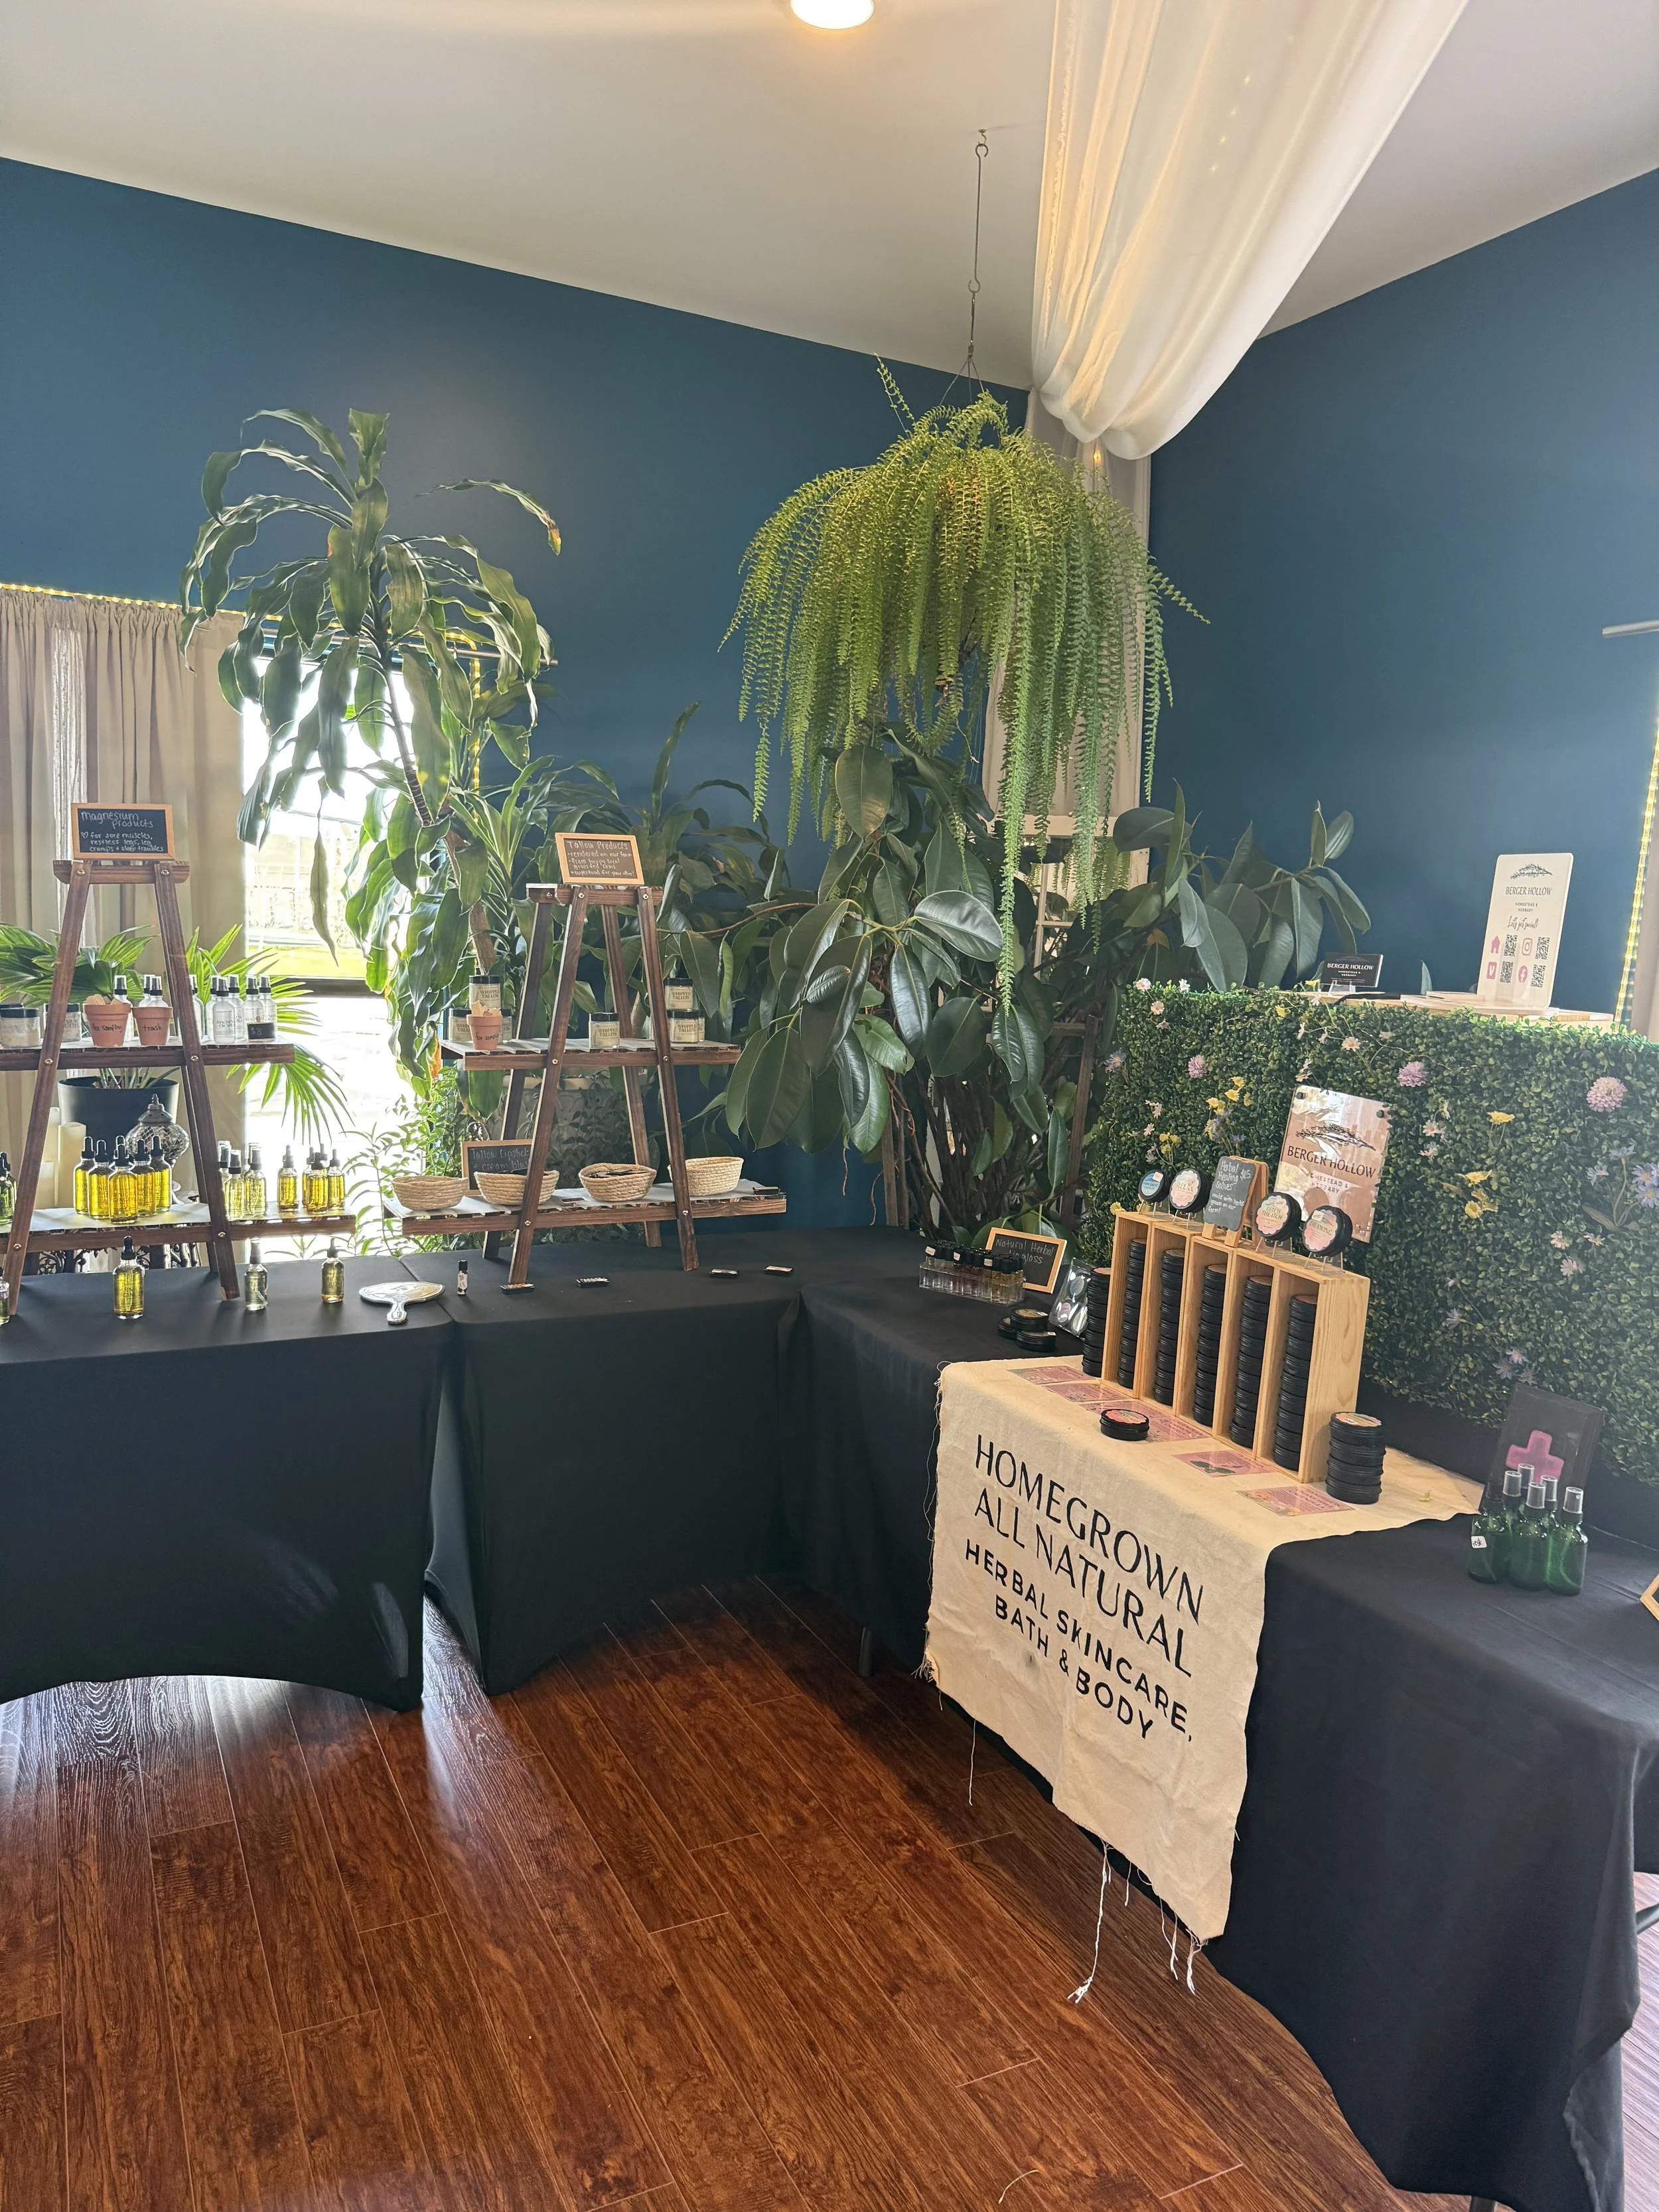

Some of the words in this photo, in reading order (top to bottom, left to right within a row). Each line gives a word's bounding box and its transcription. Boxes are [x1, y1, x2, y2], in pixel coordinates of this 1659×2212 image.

[111, 819, 154, 829] products
[567, 841, 594, 849] Tallow
[597, 841, 628, 849] Products
[1506, 887, 1527, 895] BERGER
[1528, 887, 1552, 896] HOLLOW
[470, 1148, 497, 1160] Tallow
[1287, 1146, 1327, 1167] BERGER
[1330, 1159, 1376, 1179] HOLLOW
[1218, 1171, 1238, 1184] Healing
[1240, 1169, 1251, 1181] $15
[1176, 1182, 1193, 1192] RELAX
[1216, 1181, 1233, 1191] Salves
[995, 1238, 1027, 1250] Natural
[1031, 1242, 1054, 1256] Herbal
[1022, 1253, 1043, 1265] gloss
[975, 1435, 1204, 1623] HOMEGROWN
[974, 1488, 1025, 1548] ALL
[1036, 1525, 1192, 1678] NATURAL
[965, 1538, 1048, 1619] HERBAL
[1056, 1610, 1192, 1742] SKINCARE,
[995, 1595, 1049, 1657] BATH
[1059, 1650, 1070, 1677] &
[1076, 1667, 1153, 1739] BODY
